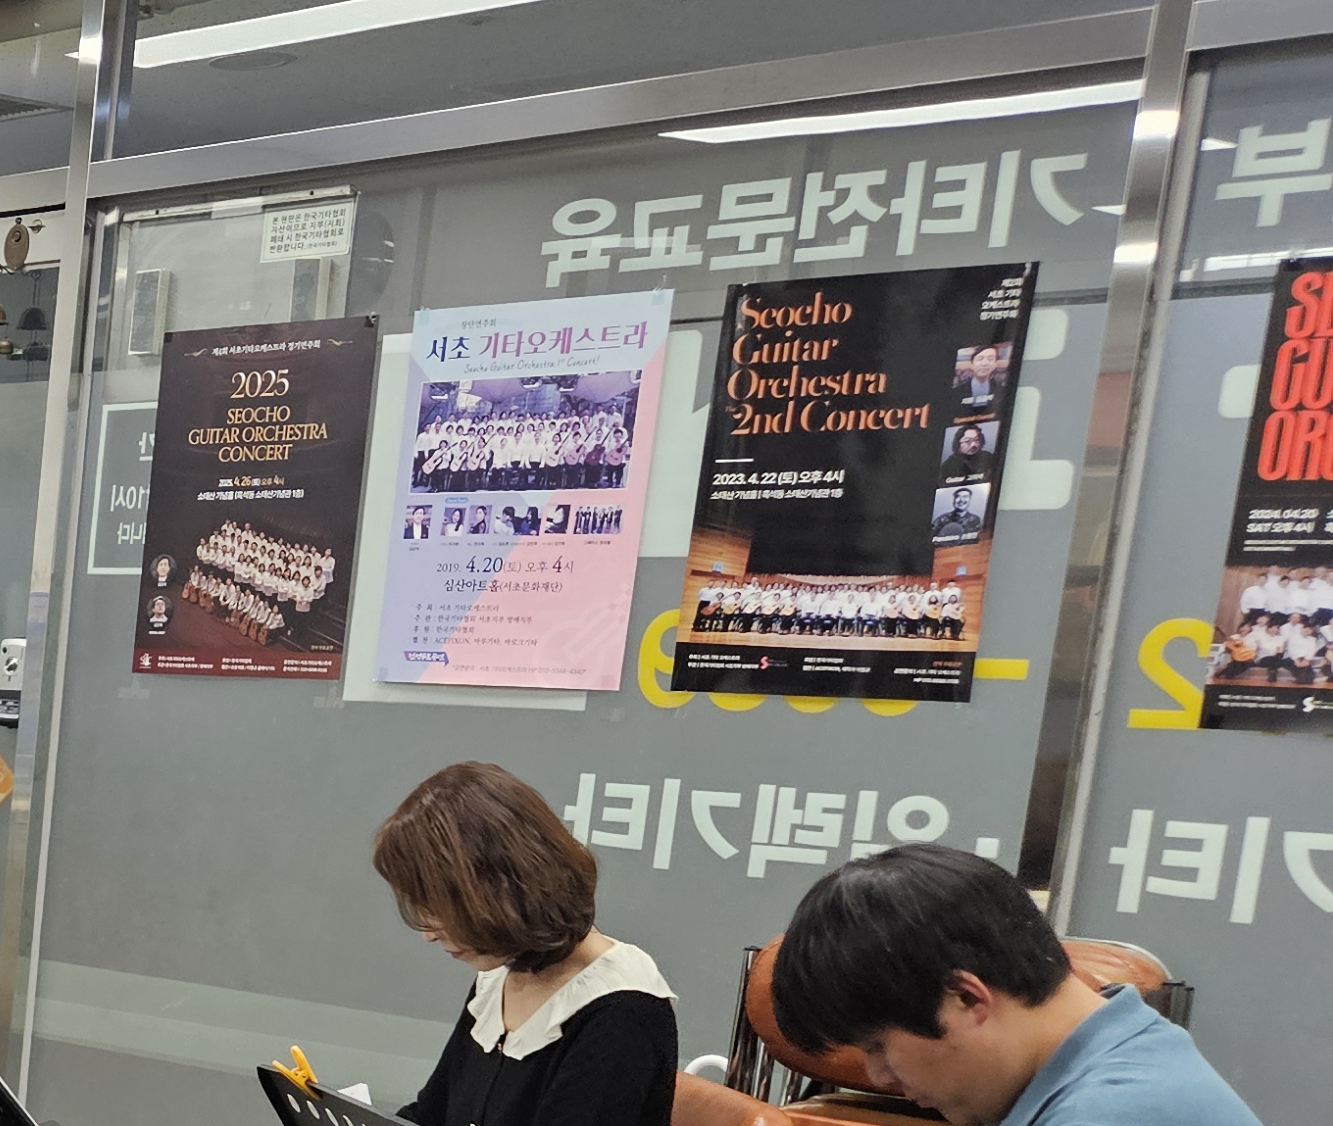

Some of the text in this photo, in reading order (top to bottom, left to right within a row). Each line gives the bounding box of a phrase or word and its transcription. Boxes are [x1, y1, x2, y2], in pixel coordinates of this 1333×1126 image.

[304, 208, 346, 222] 한국기타협회
[740, 291, 854, 329] Seocho
[426, 320, 649, 363] 서초 기타오케스트라
[732, 329, 840, 365] Guitar
[230, 368, 290, 399] 2025
[727, 364, 888, 400] Orchestra
[227, 405, 291, 426] SEOCHO
[731, 399, 931, 436] 2nd Concert
[188, 422, 328, 446] GUITAR ORCHESTRA
[218, 443, 293, 463] CONCERT
[712, 472, 747, 485] 2023.
[798, 470, 823, 484] 오후
[823, 469, 845, 484] 4시
[436, 563, 461, 573] 2019.
[525, 561, 548, 573] 오후
[552, 555, 575, 573] 4시
